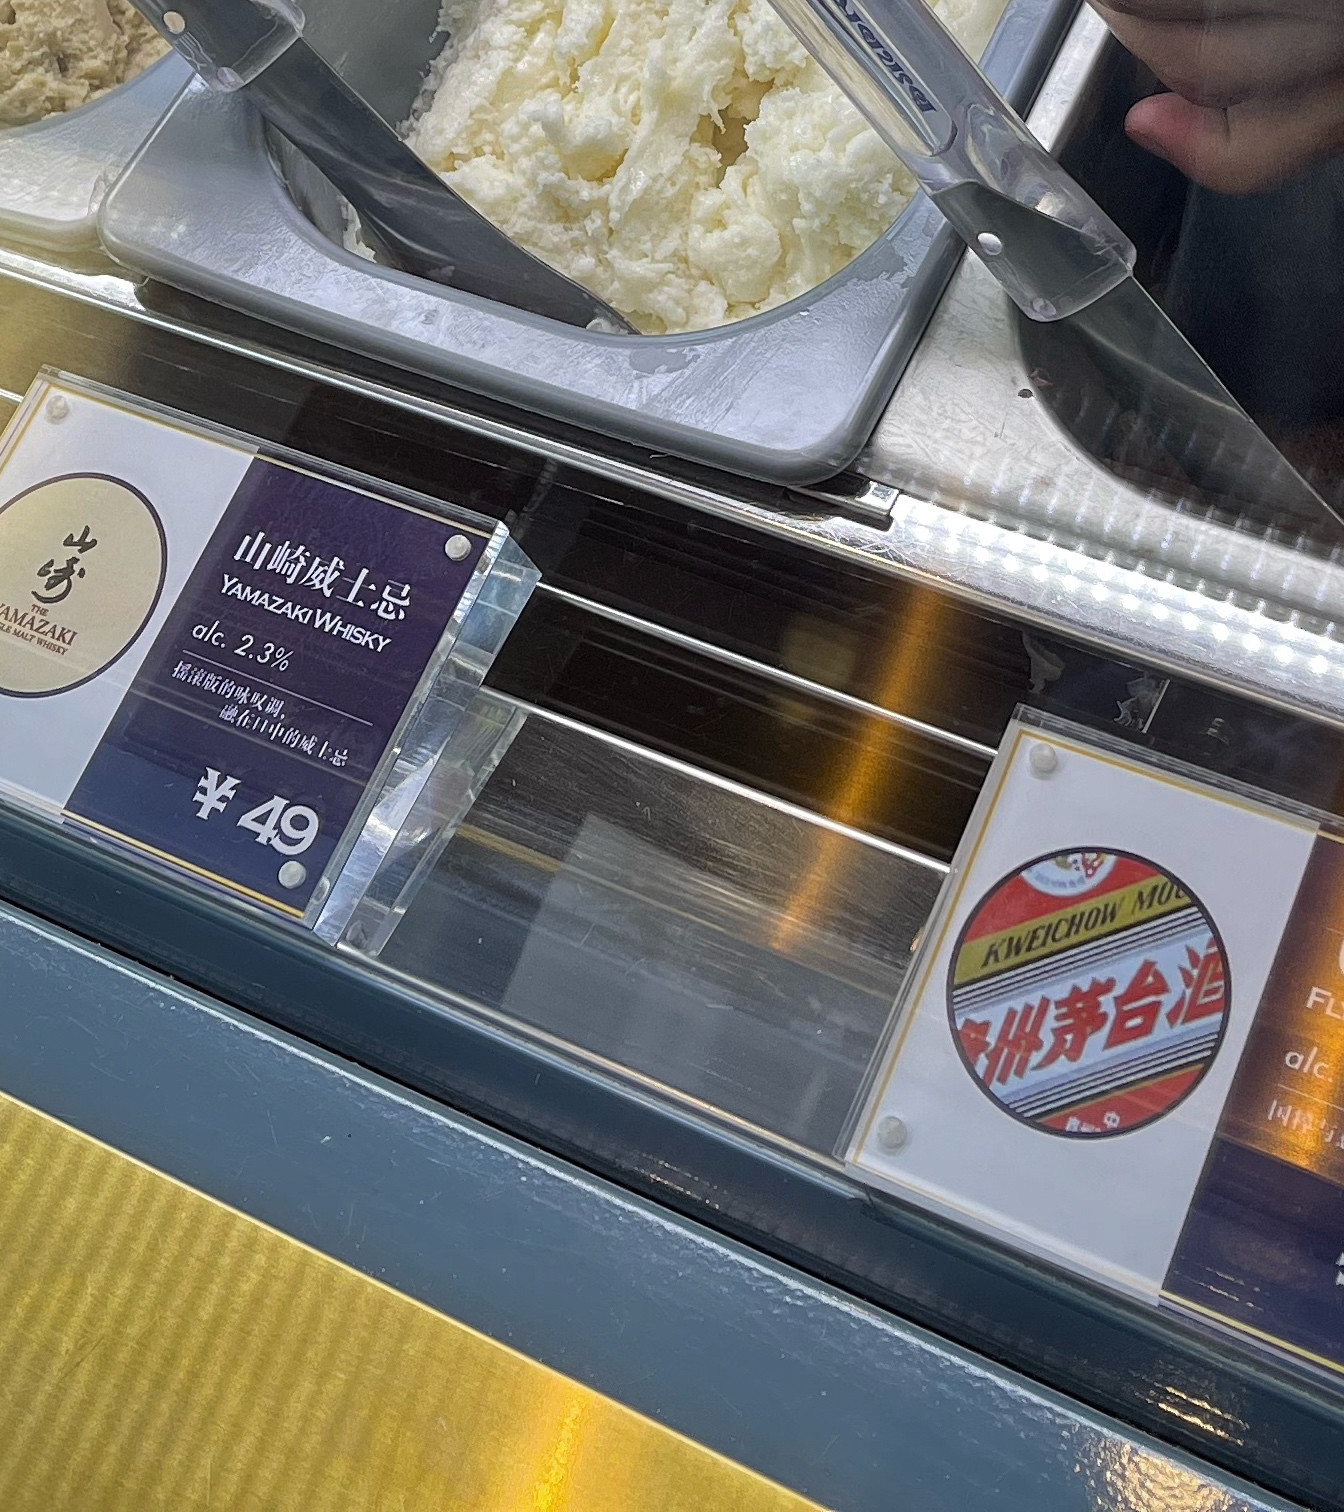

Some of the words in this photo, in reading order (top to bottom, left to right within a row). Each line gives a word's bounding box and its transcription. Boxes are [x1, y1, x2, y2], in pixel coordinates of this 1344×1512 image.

[234, 531, 411, 620] 山崎威士忌
[30, 603, 49, 617] THE
[221, 574, 313, 624] YAMAZAKI
[314, 609, 391, 653] WHISKY
[11, 628, 36, 643] MALT
[36, 637, 69, 656] WHISKY
[192, 620, 226, 649] alc.
[234, 634, 294, 672] 2.3%
[236, 795, 319, 856] 49
[980, 896, 1125, 969] KWEICHOW
[1285, 1046, 1333, 1082] alc.
